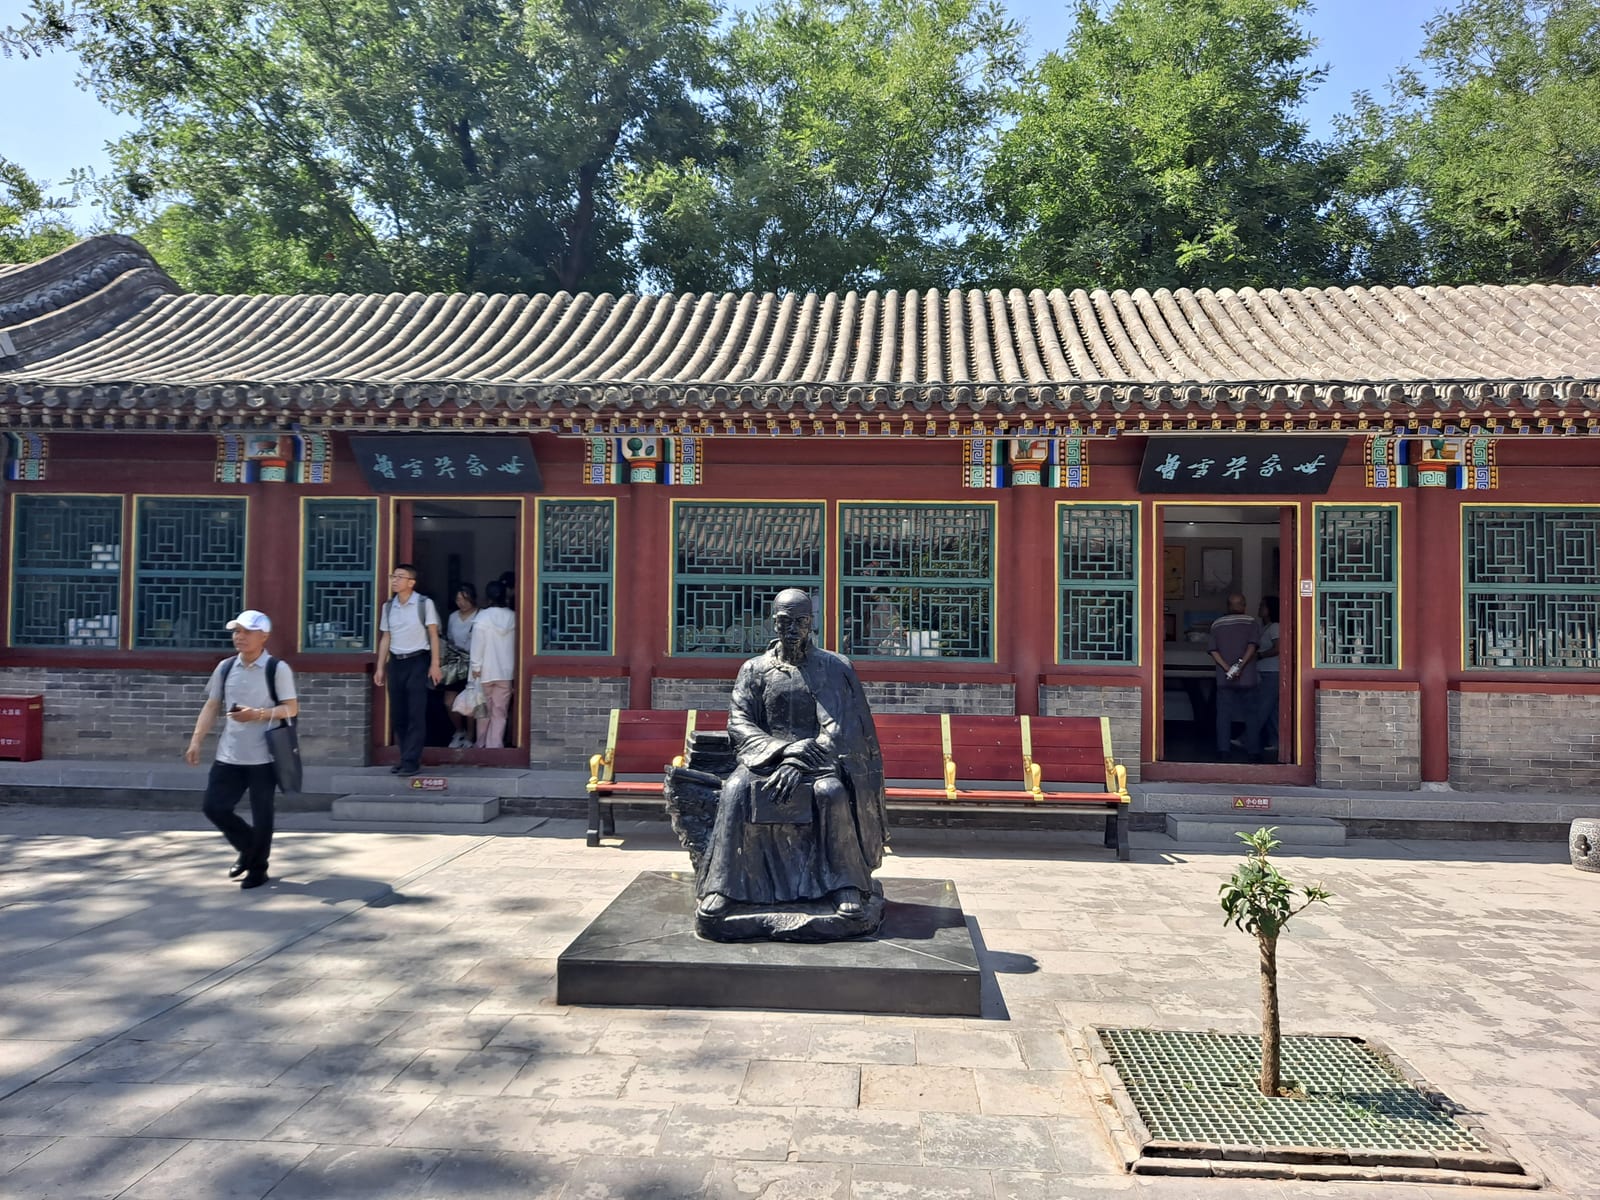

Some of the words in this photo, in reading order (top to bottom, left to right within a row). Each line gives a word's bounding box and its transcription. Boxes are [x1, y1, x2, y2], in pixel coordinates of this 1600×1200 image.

[372, 452, 526, 480] 曹雪芹家世
[1154, 452, 1327, 481] 曹雪芹家世
